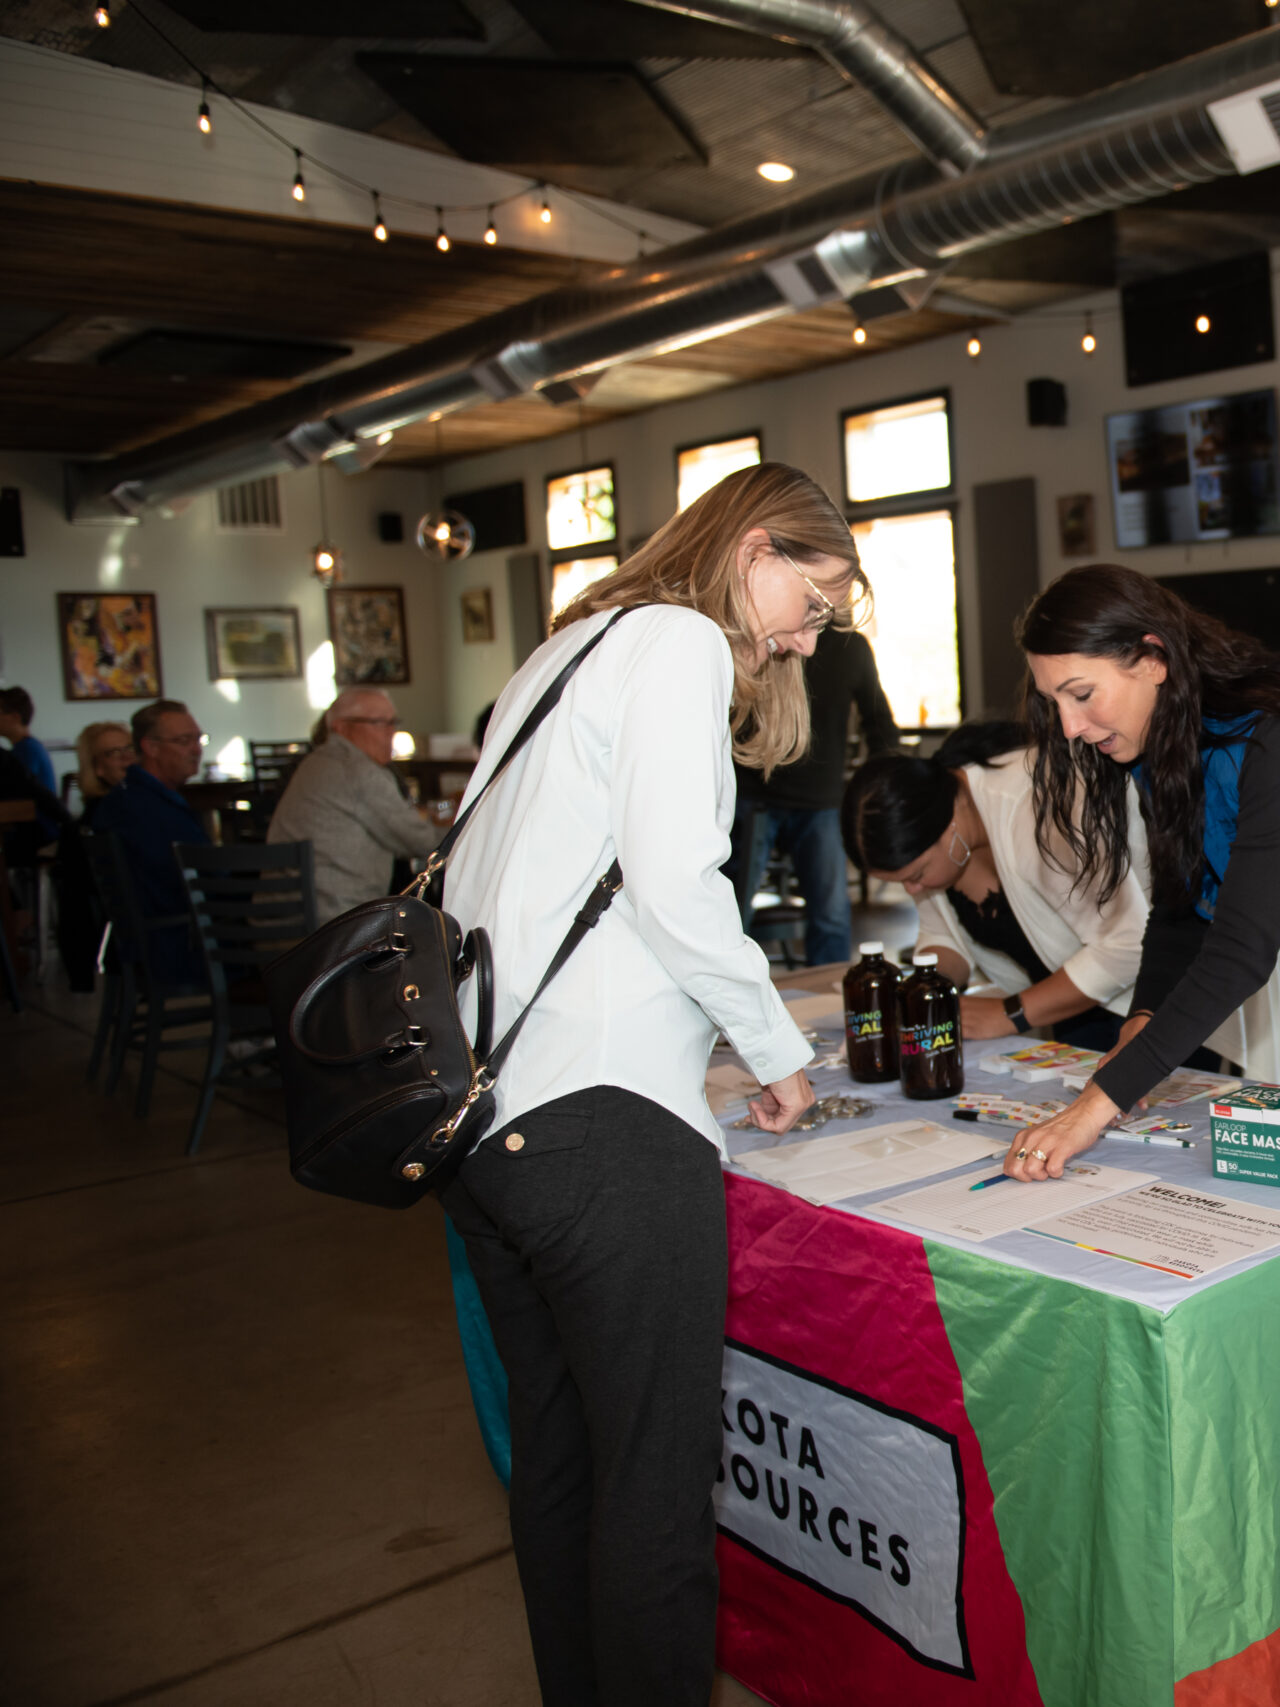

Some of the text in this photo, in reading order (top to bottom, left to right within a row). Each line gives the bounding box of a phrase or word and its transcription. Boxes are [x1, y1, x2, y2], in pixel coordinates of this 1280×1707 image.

[1214, 1120, 1247, 1132] EARLOOP
[1214, 1129, 1249, 1146] FACE
[1149, 1186, 1227, 1209] WELCOME!
[716, 1452, 912, 1588] OURCES
